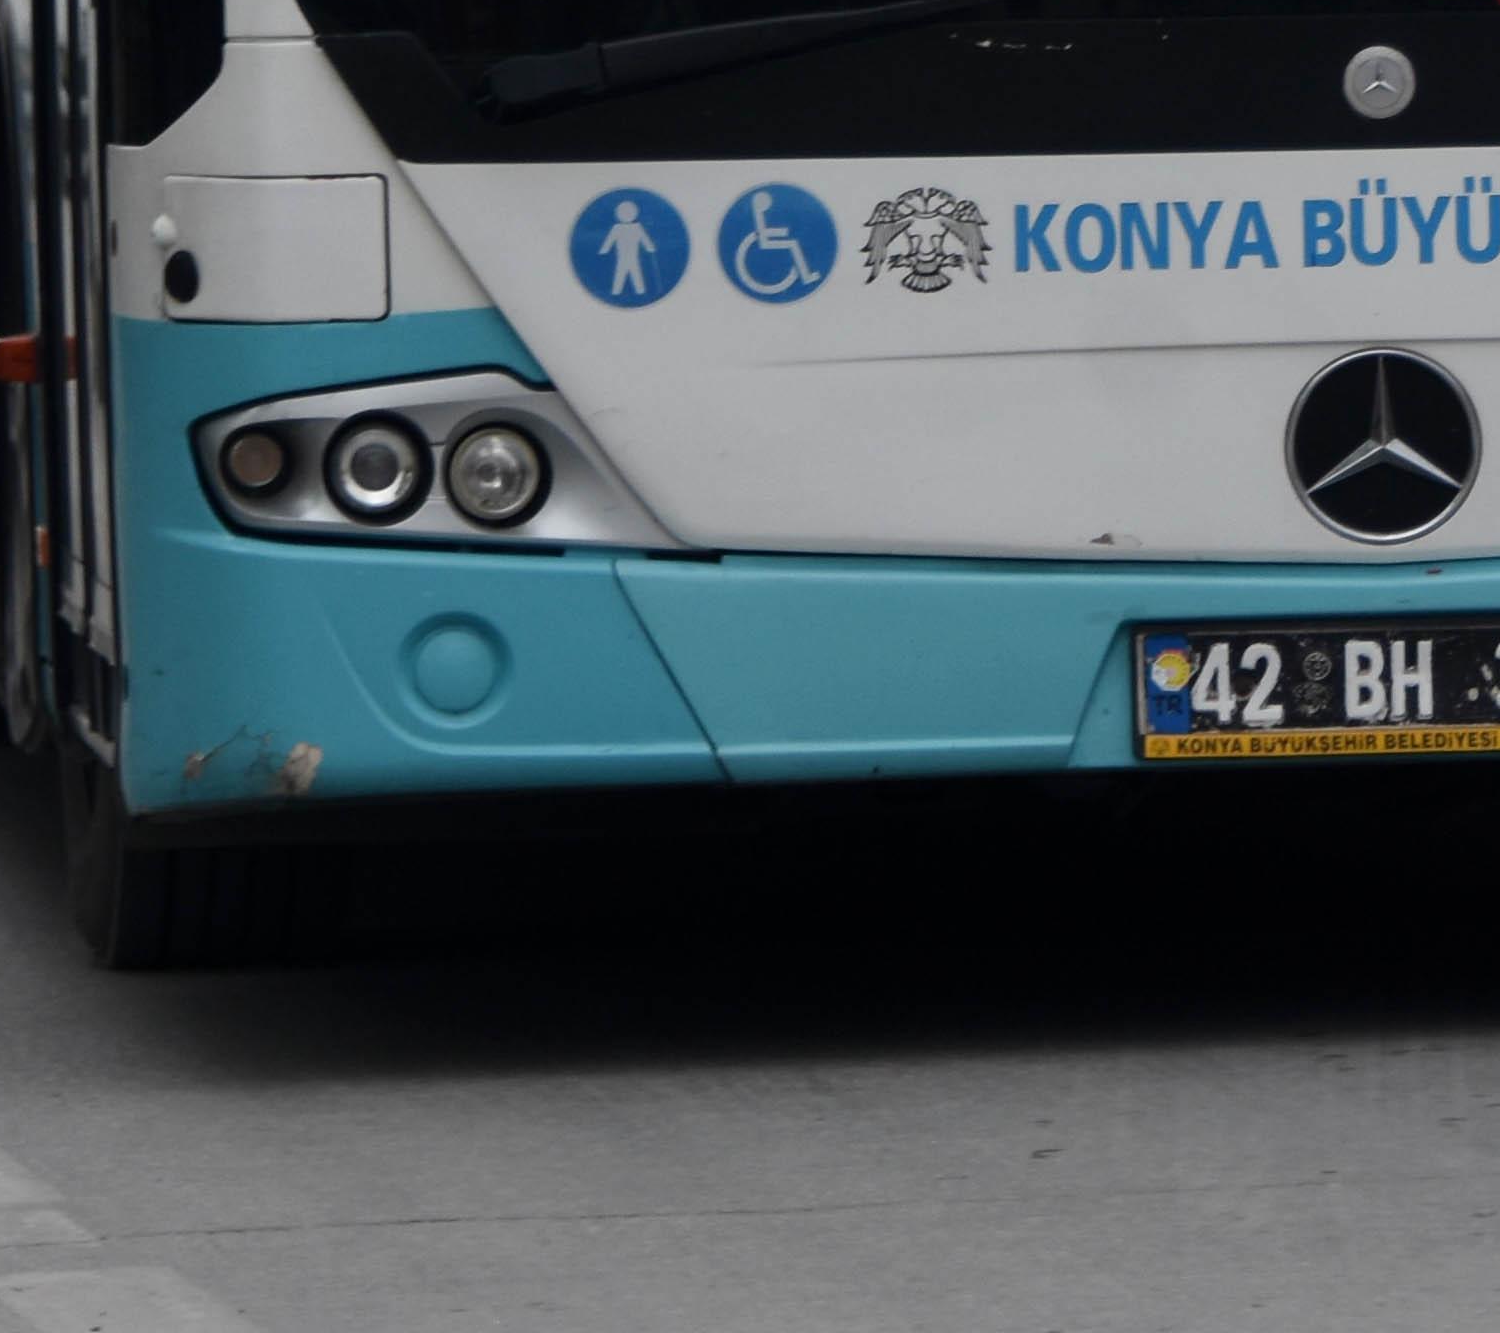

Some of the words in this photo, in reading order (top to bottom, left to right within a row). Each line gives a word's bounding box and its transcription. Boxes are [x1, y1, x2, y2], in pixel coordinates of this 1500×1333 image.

[1015, 200, 1279, 273] KONYA
[1152, 694, 1183, 716] TR
[1190, 641, 1284, 727] 42
[1344, 640, 1433, 722] BH
[1177, 737, 1243, 755] KONYA
[1250, 733, 1377, 754] BÜYÜKŞEHİR
[1384, 731, 1498, 750] BELEDİYESİ
